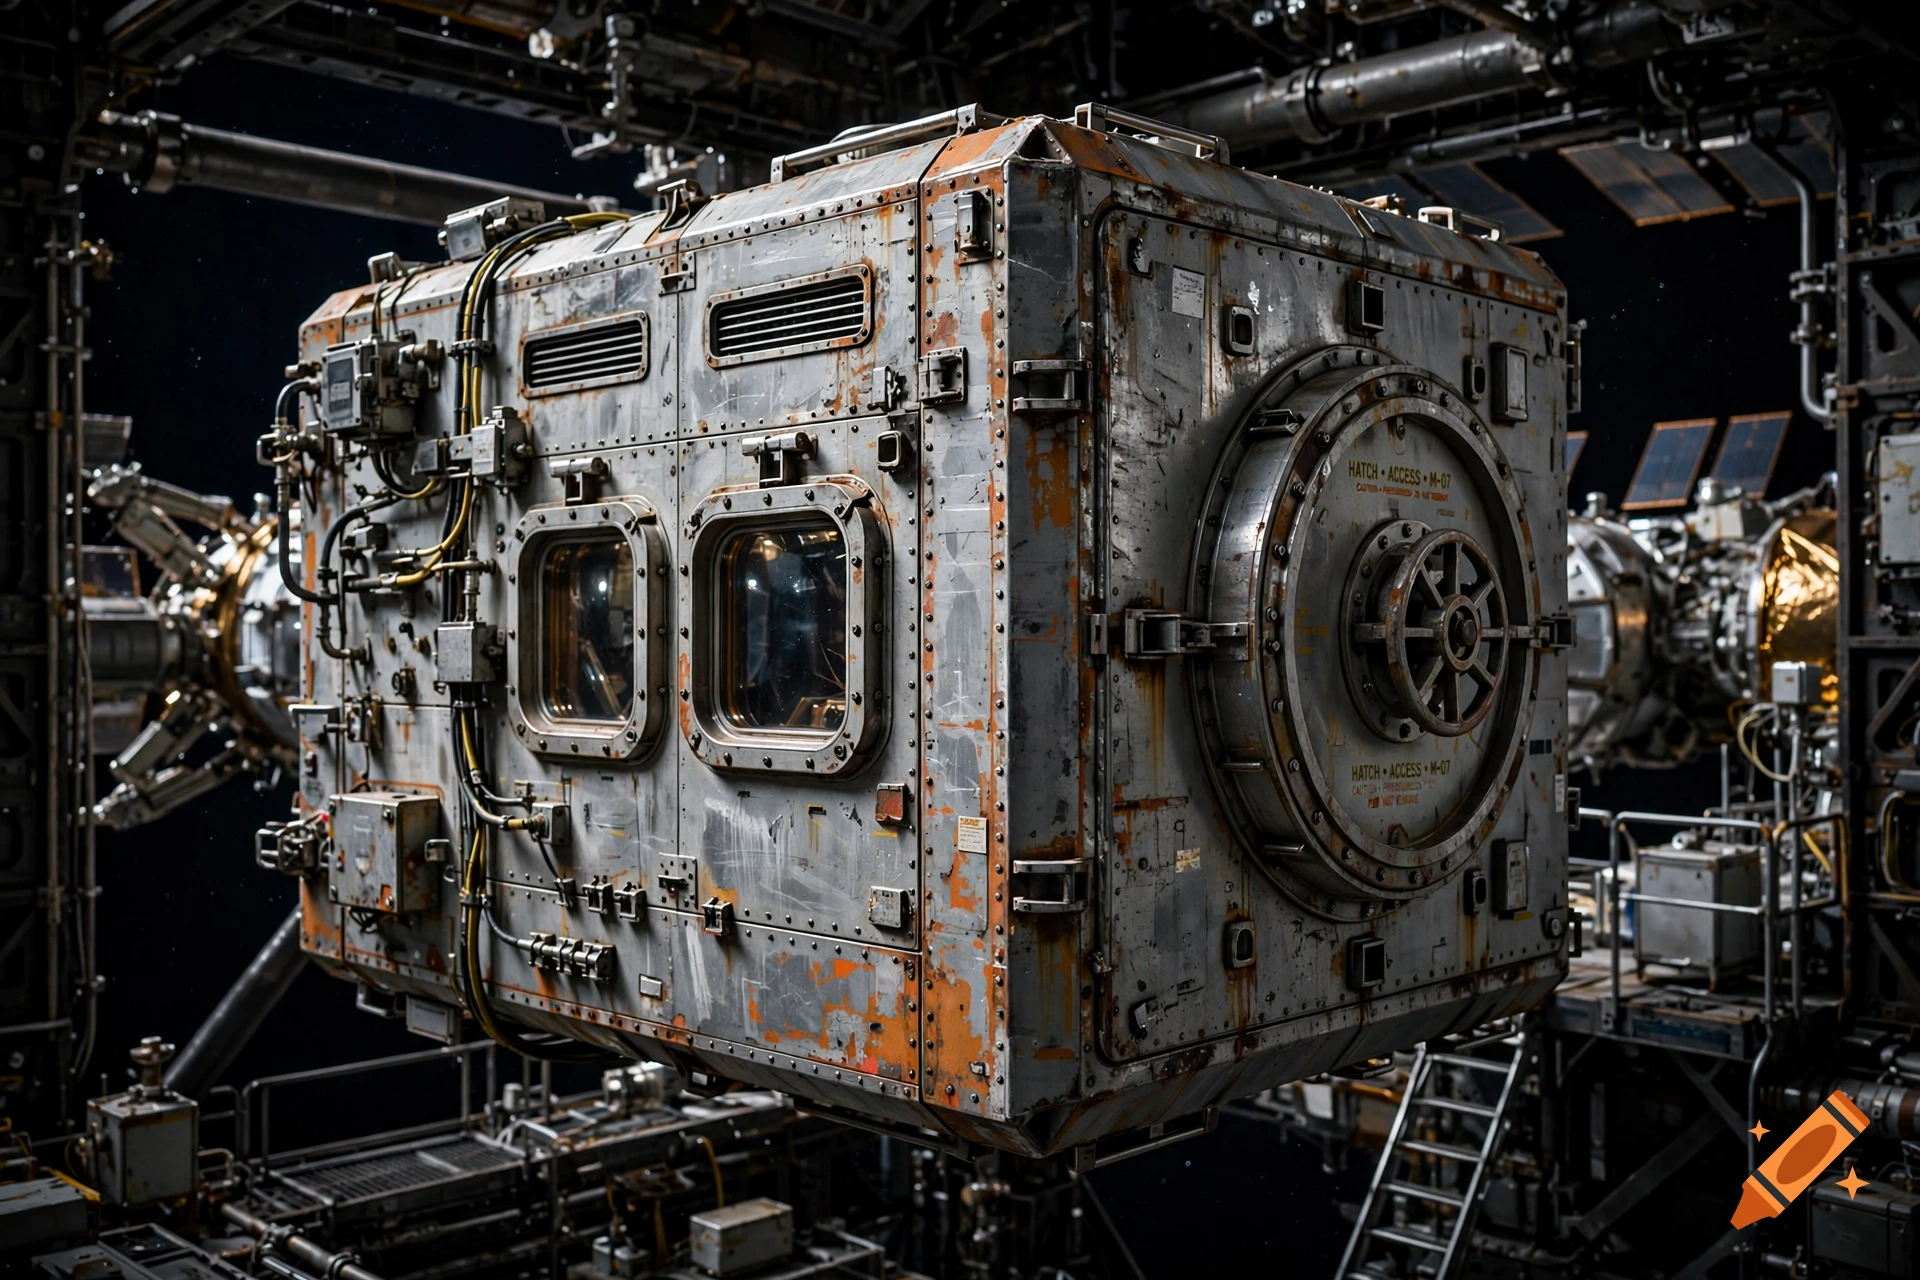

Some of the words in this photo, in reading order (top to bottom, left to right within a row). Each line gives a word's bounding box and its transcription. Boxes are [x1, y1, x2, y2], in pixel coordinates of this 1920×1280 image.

[1348, 460, 1378, 480] HATCH
[1387, 465, 1421, 486] ACCESS
[1429, 471, 1451, 490] M-07
[1351, 764, 1380, 781] HATCH
[1389, 762, 1421, 779] ACCESS
[1430, 760, 1451, 776] M-07
